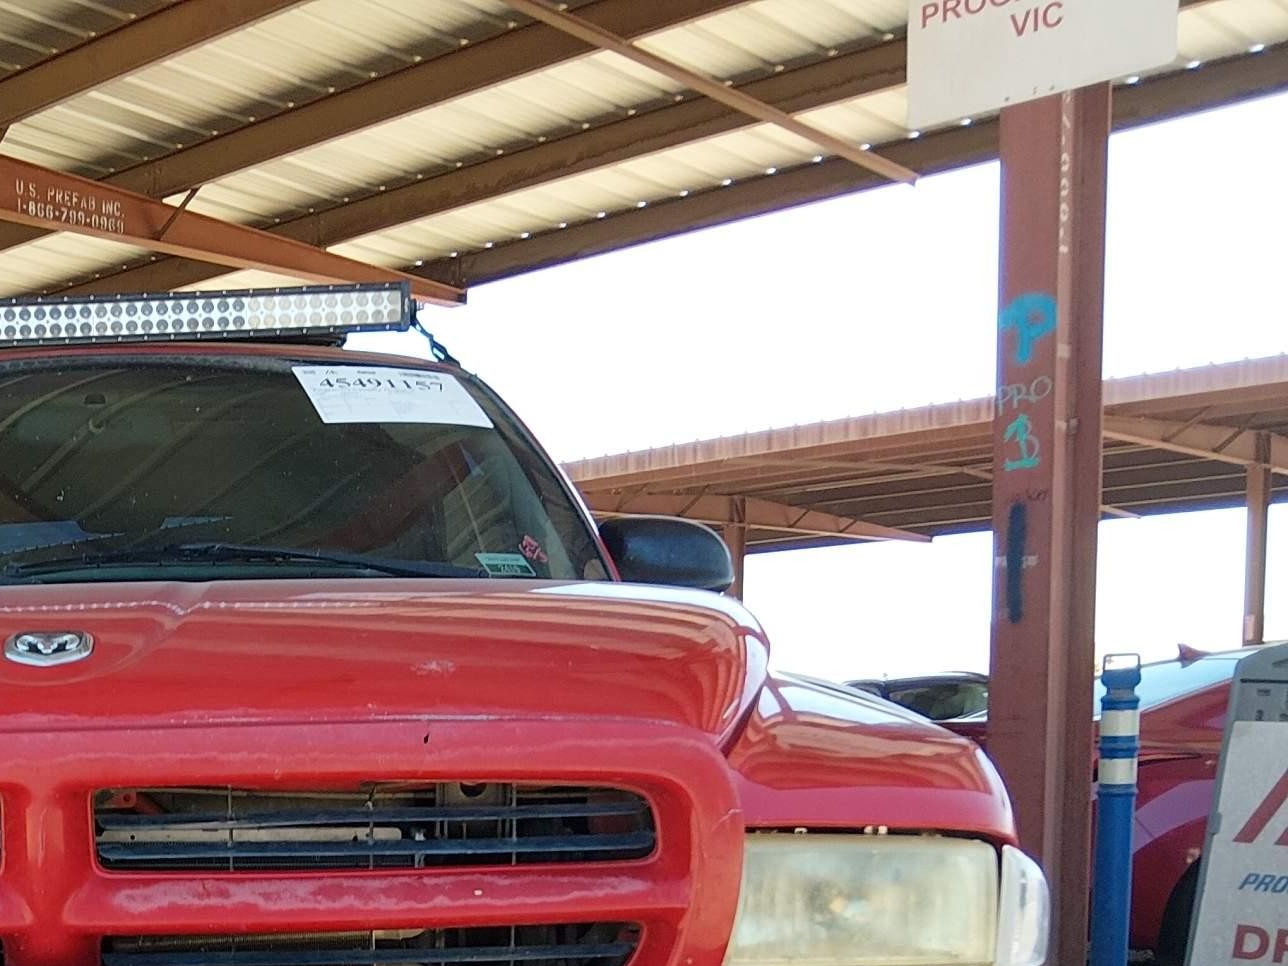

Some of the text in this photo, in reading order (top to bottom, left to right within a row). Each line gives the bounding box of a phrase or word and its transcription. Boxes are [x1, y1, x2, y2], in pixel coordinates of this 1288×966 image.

[921, 0, 1020, 29] PRO
[1010, 2, 1063, 37] VIC
[15, 178, 125, 218] U.S. PREFAB INC.
[319, 377, 444, 393] 45491157
